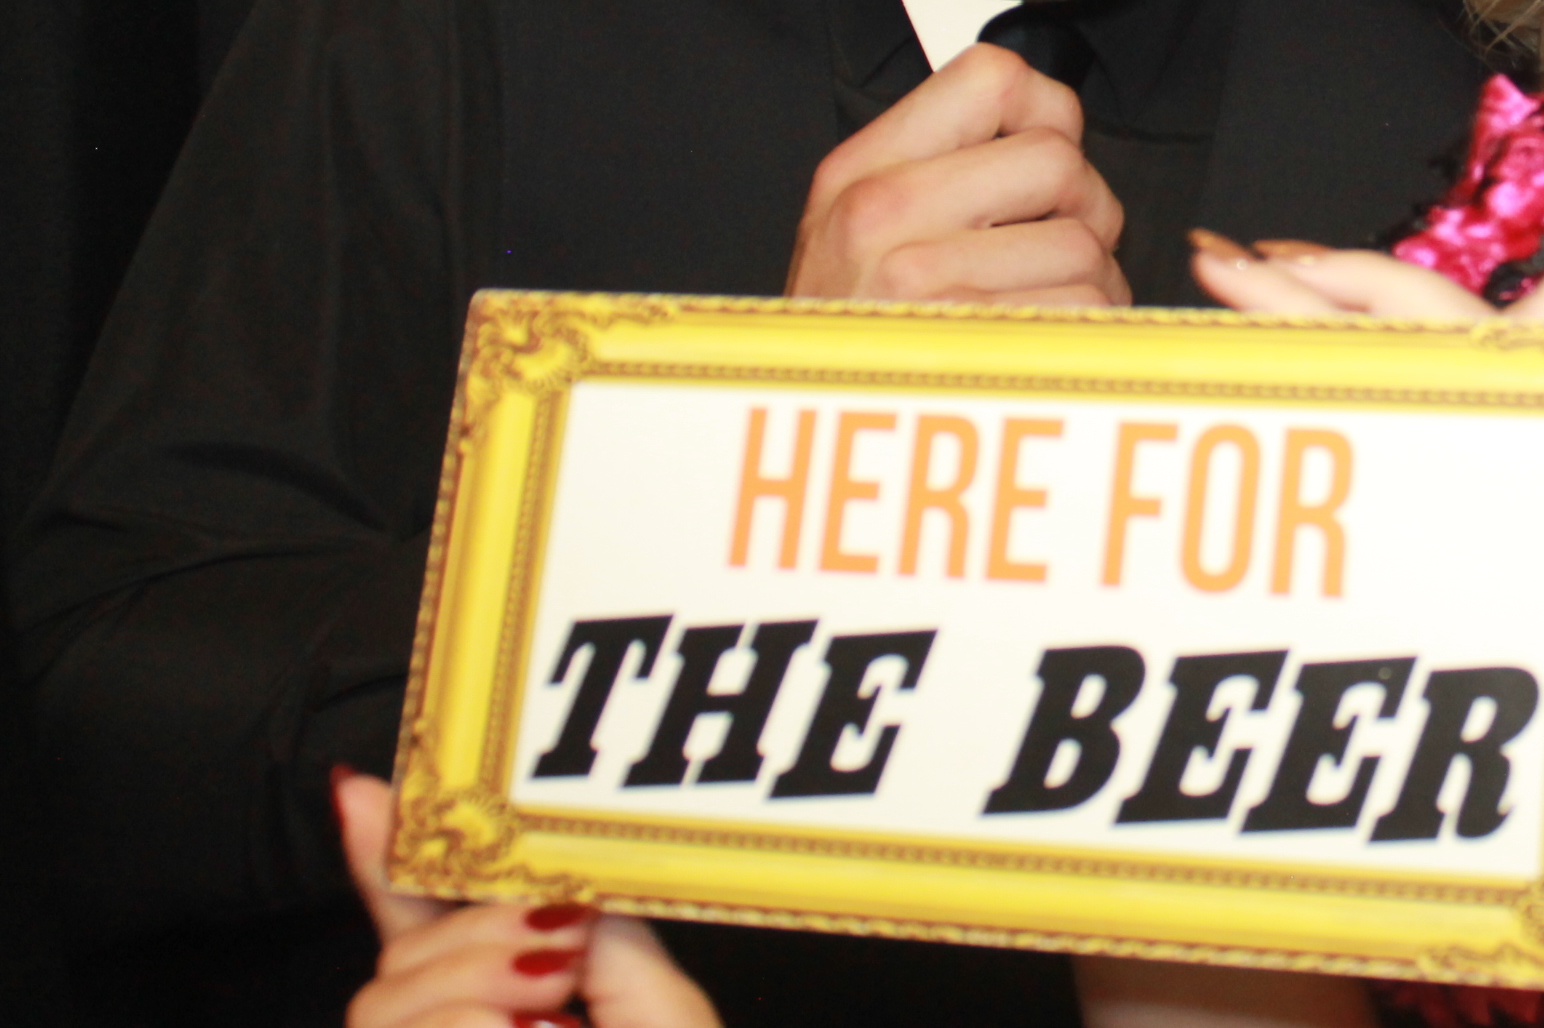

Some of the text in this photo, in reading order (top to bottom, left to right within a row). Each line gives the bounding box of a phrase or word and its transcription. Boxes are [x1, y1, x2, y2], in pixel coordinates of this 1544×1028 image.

[727, 406, 1356, 598] HERE FOR
[530, 614, 1541, 844] THE BEER
